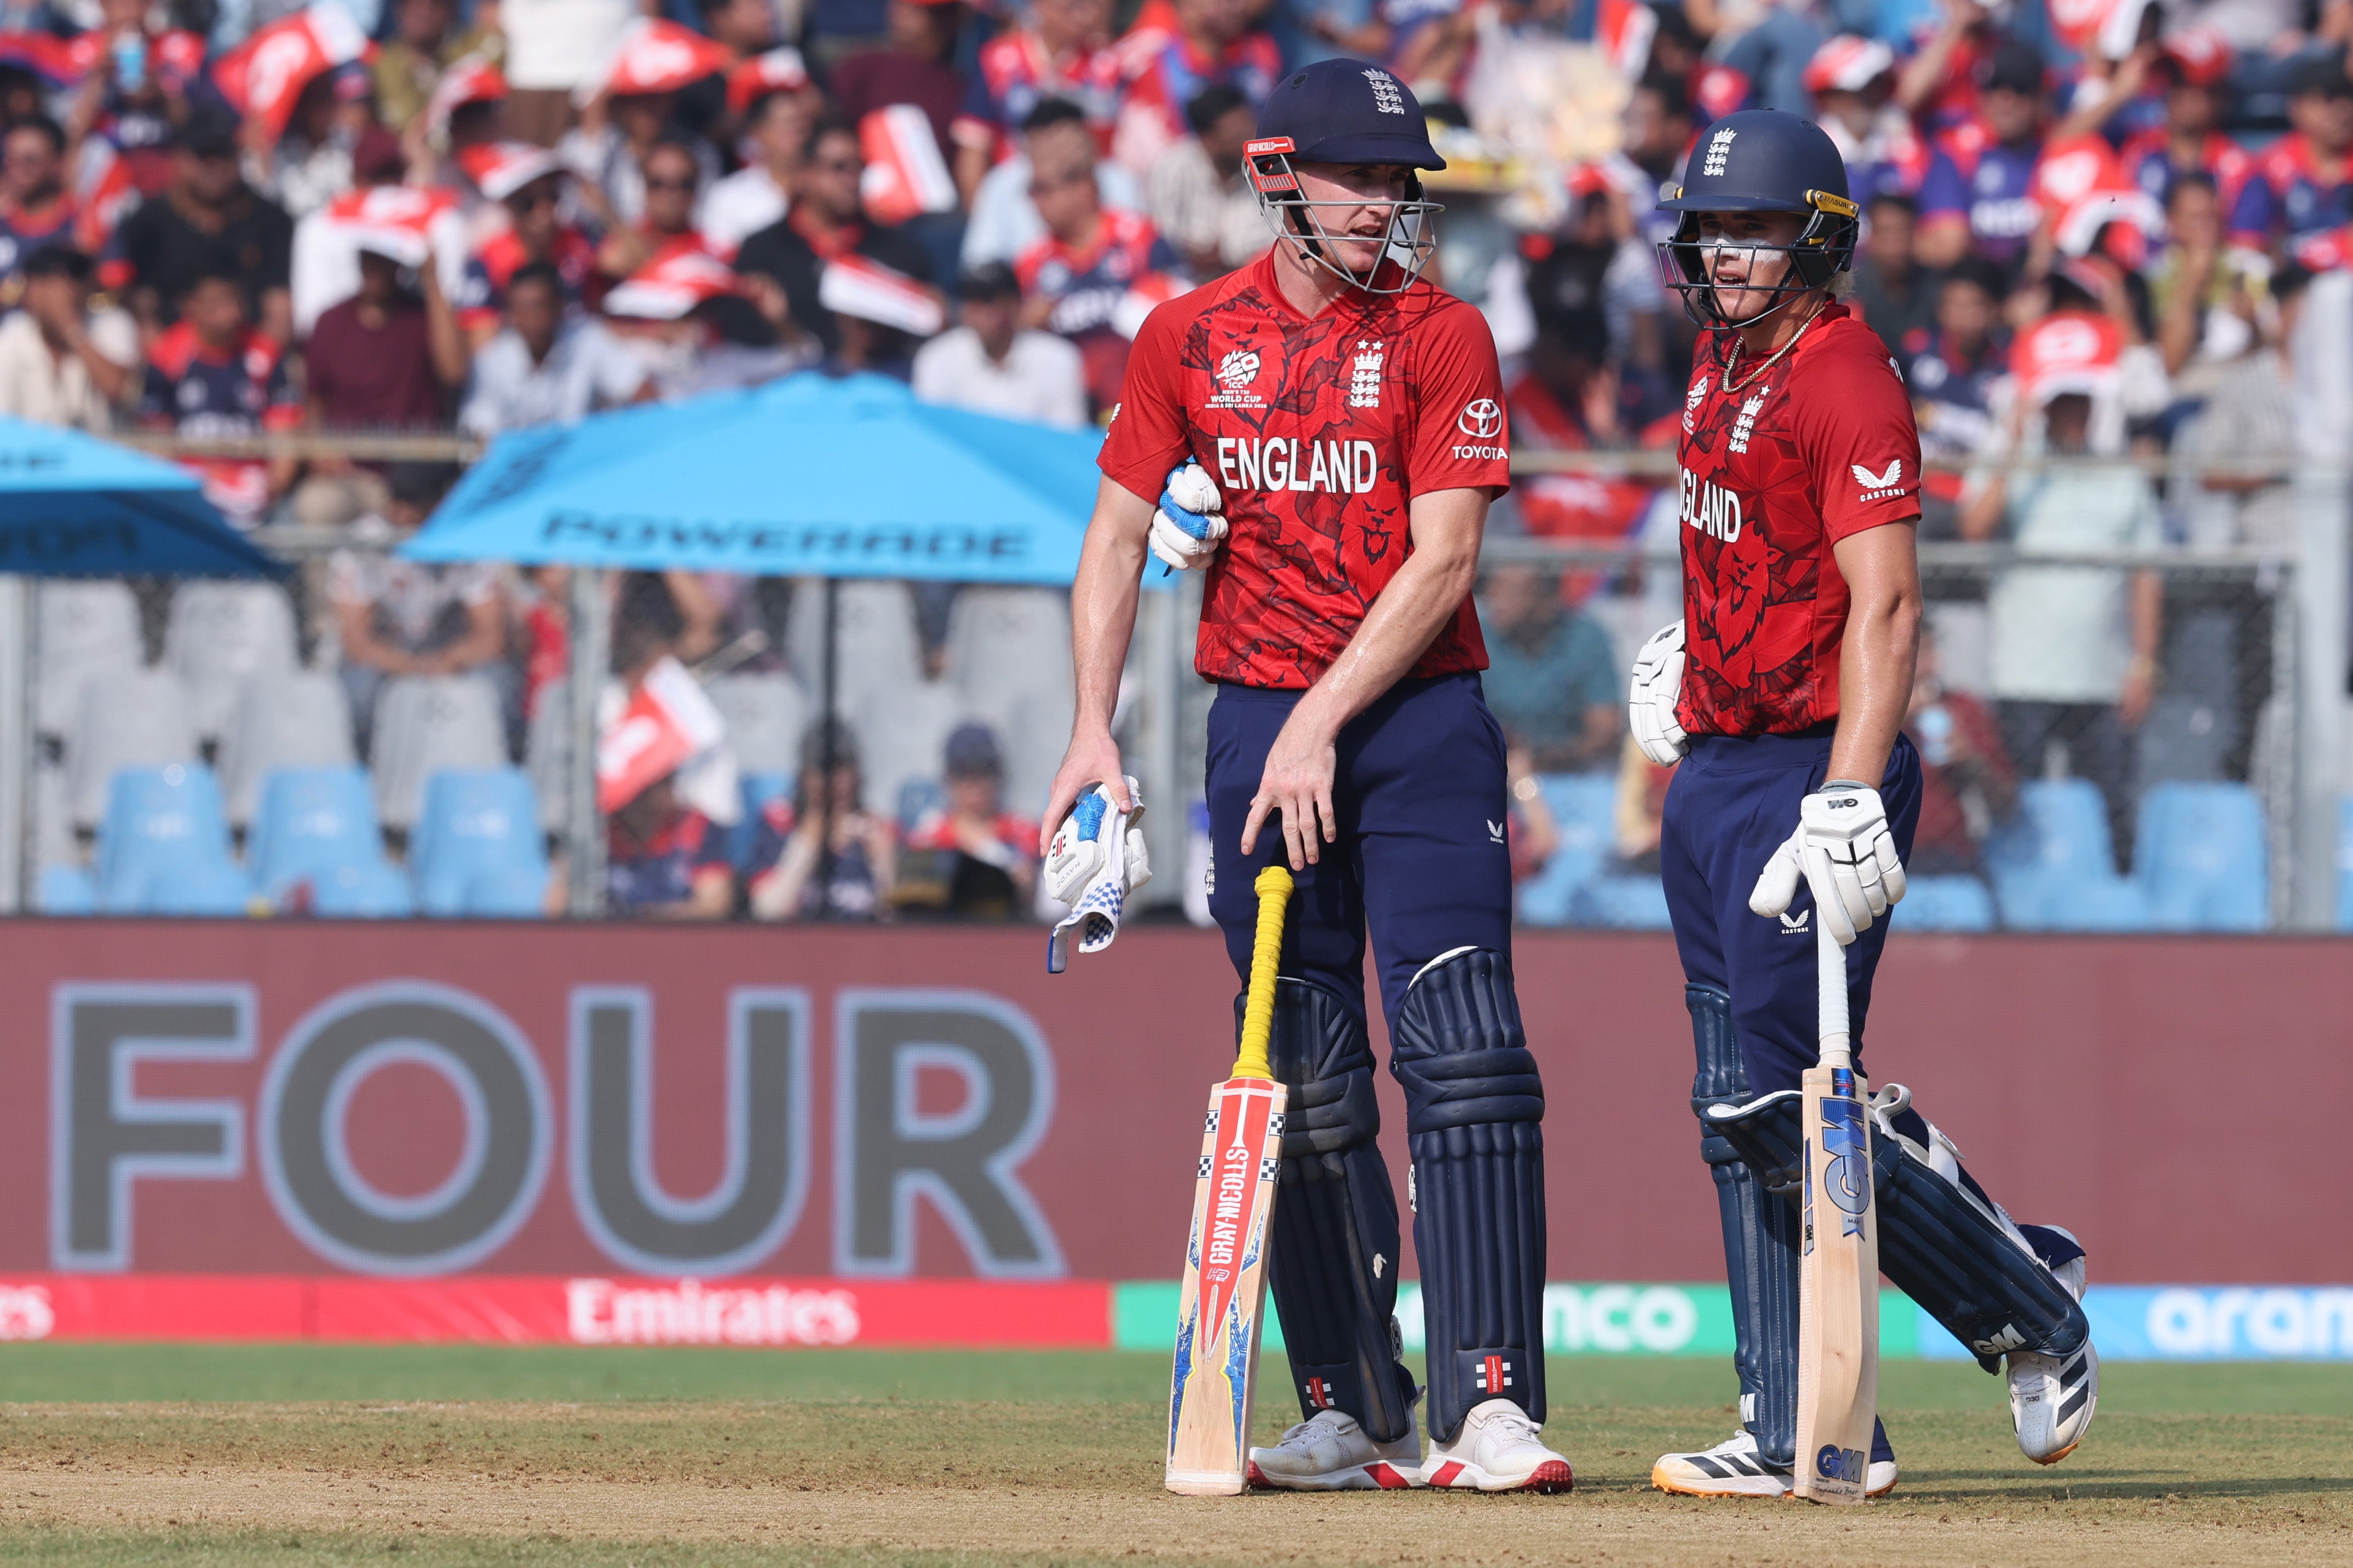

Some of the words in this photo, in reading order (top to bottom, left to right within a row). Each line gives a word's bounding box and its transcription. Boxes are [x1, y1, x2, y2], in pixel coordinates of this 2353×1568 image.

[1825, 196, 1849, 209] MASURI
[1217, 437, 1377, 493] ENGLAND
[1452, 445, 1509, 460] TOYOTA
[1860, 489, 1905, 502] CASTORE
[1056, 862, 1080, 888] HAVOC
[50, 980, 1069, 1280] FOUR
[1209, 1148, 1250, 1264] GRAY-NICOLLS
[1806, 1224, 1813, 1241] GM
[565, 1278, 861, 1344] Emirates
[1974, 1323, 2026, 1354] GM
[1739, 1393, 1755, 1423] M
[1816, 1444, 1865, 1484] GM
